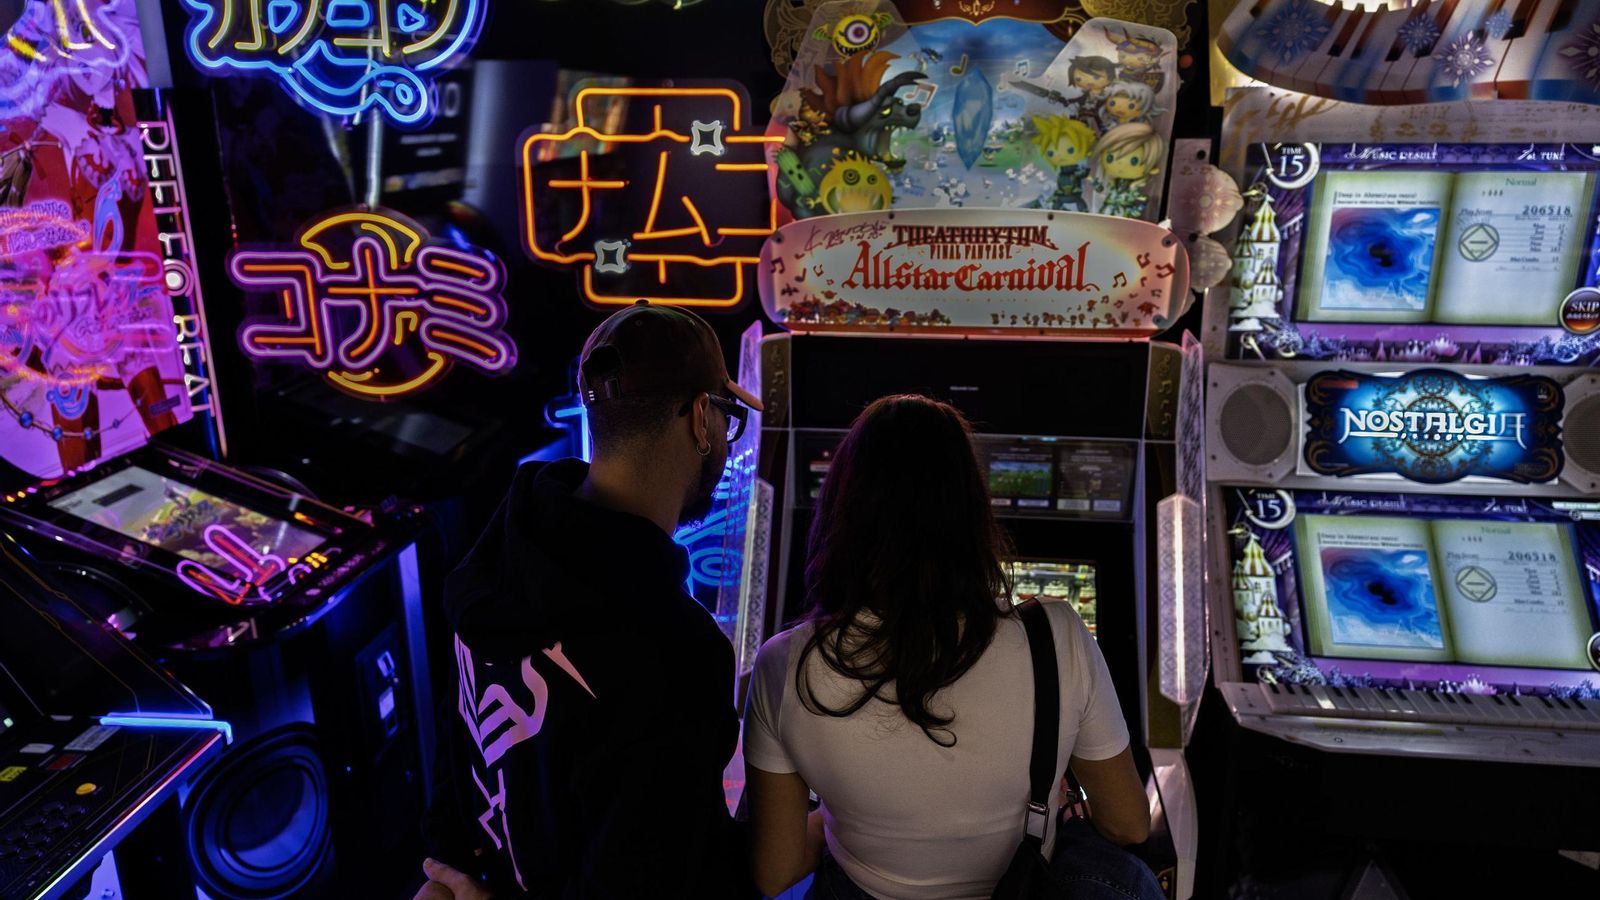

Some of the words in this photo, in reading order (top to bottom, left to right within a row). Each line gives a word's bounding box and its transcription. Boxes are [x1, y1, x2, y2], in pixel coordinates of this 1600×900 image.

[1279, 155, 1304, 177] 15
[1505, 178, 1537, 187] Normal
[1522, 205, 1571, 216] 206518
[930, 244, 961, 260] FINAL
[965, 244, 1013, 260] FANTASY
[237, 243, 503, 362] コナミ
[1571, 301, 1600, 312] SKIP
[1337, 407, 1528, 450] NOSTALGIA
[1256, 499, 1282, 518] 15
